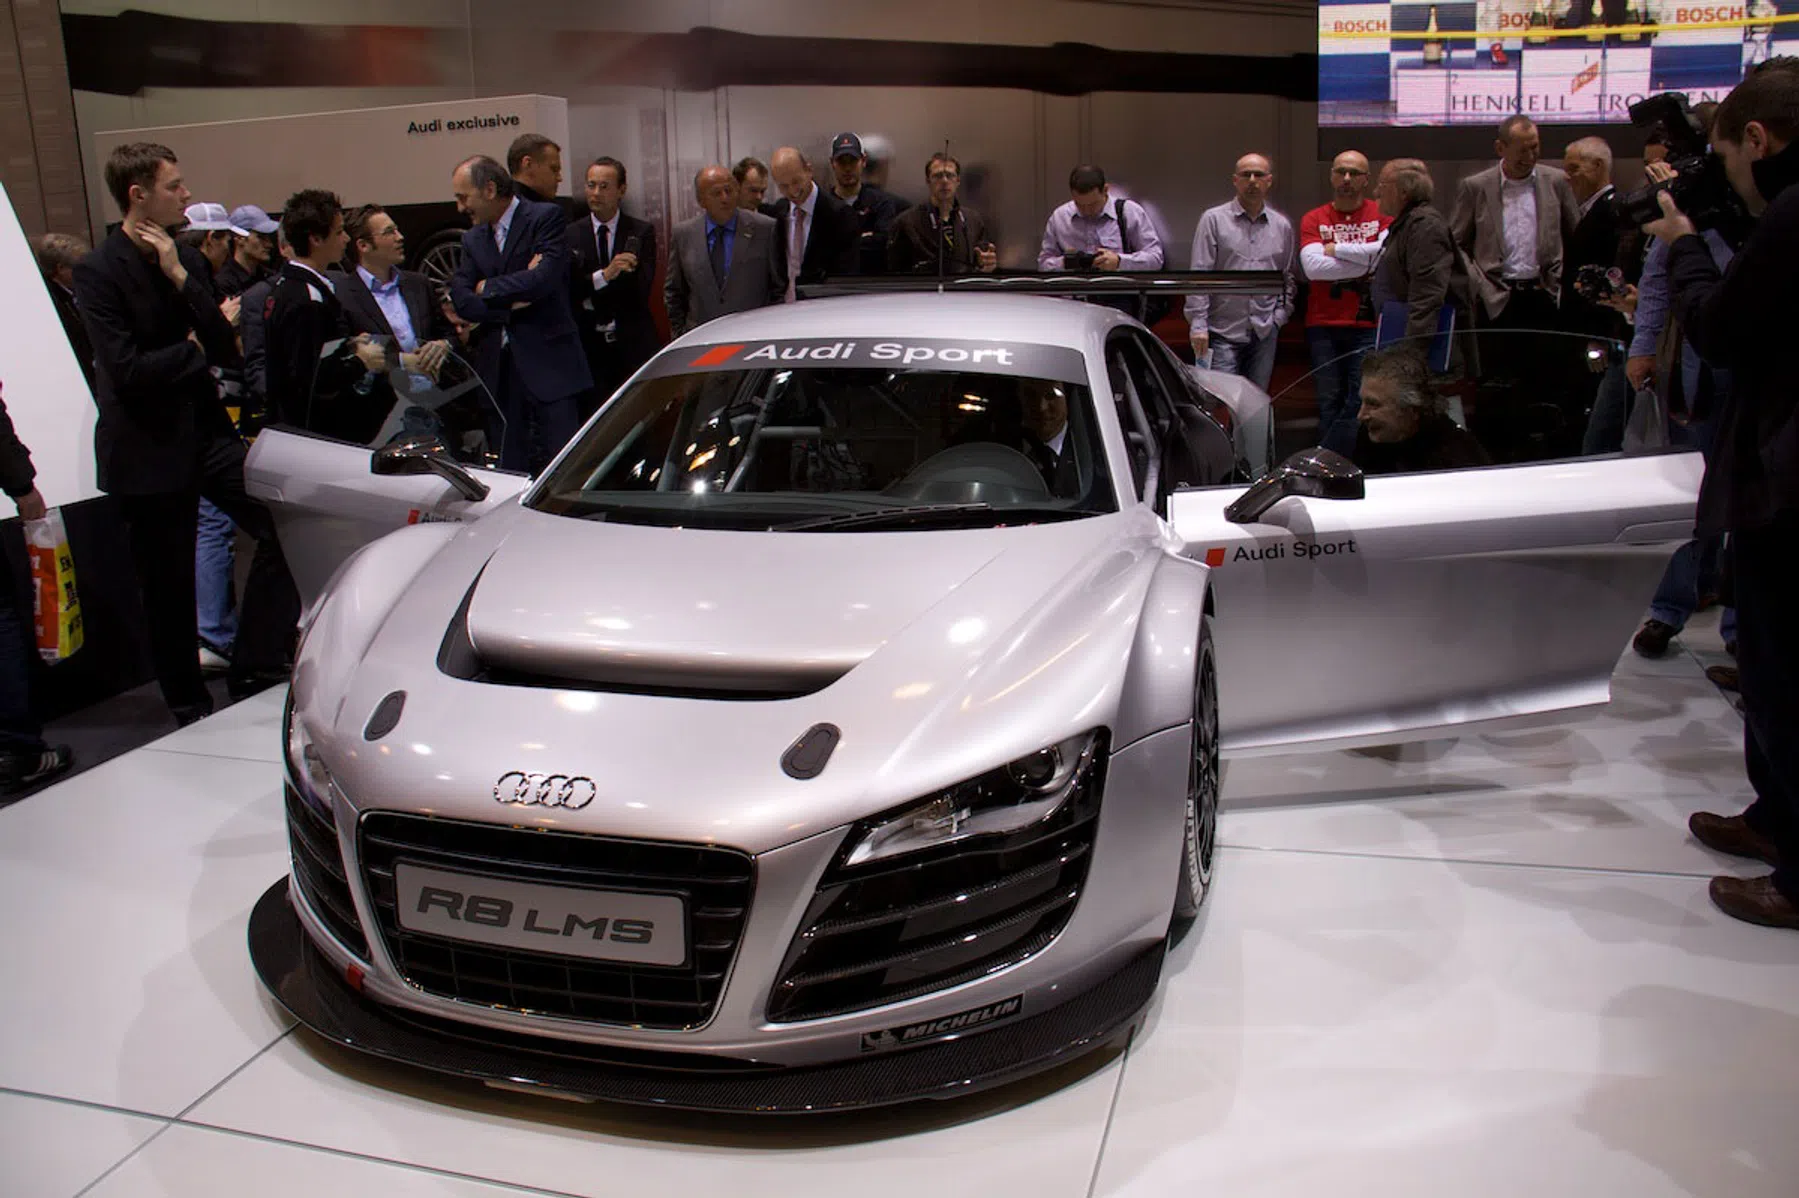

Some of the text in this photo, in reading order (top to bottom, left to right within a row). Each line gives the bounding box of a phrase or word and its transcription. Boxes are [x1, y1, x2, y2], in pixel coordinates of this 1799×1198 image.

[1334, 20, 1387, 32] BOSCH
[1676, 6, 1743, 23] BOSCH
[407, 114, 520, 133] Audi exclusive
[743, 342, 1014, 366] Audi Sport
[1233, 539, 1356, 562] Audi Sport
[416, 886, 655, 945] R8 LMS
[903, 999, 1019, 1040] MICHELIN
